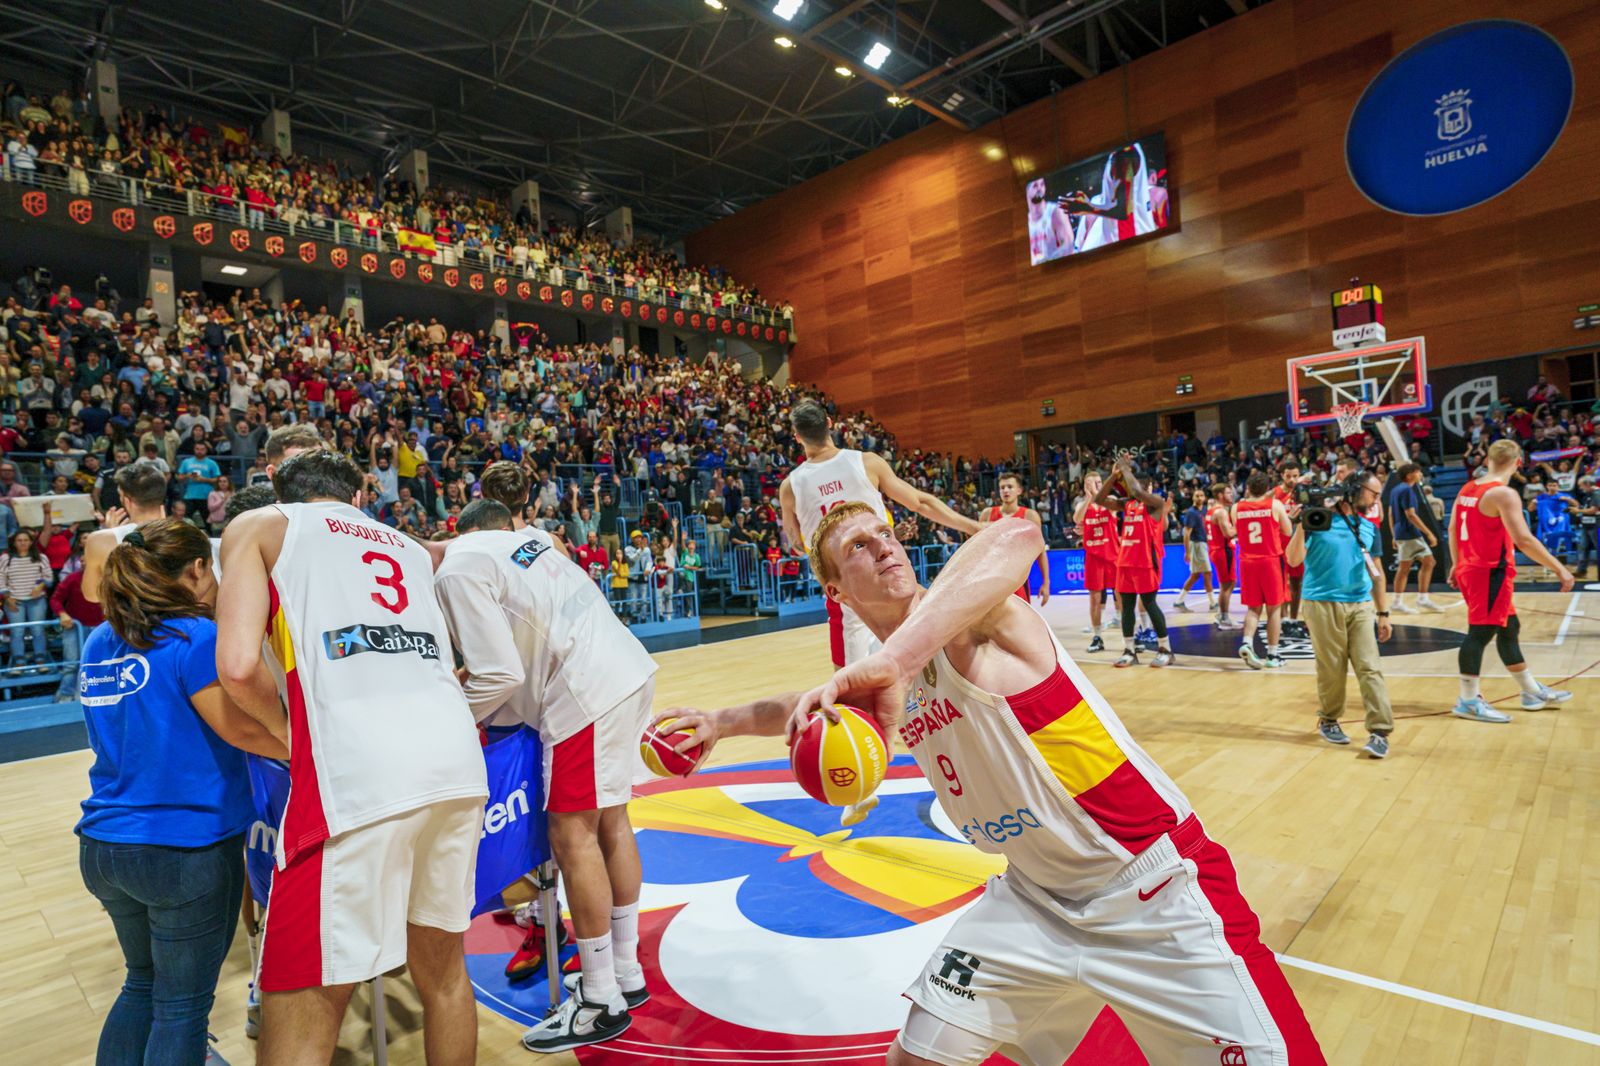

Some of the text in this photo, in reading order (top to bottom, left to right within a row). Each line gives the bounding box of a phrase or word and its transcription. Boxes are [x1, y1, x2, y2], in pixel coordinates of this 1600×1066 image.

[1425, 143, 1488, 168] HUELVA
[1336, 327, 1375, 340] renfe
[818, 480, 844, 496] YUSTA
[325, 518, 405, 548] BUSQUETS
[1247, 521, 1263, 544] 2
[1460, 511, 1469, 541] 1
[361, 550, 409, 615] 3
[899, 698, 963, 749] ESPAÑA
[936, 754, 963, 797] 9
[480, 788, 530, 839] en
[928, 974, 976, 1001] network
